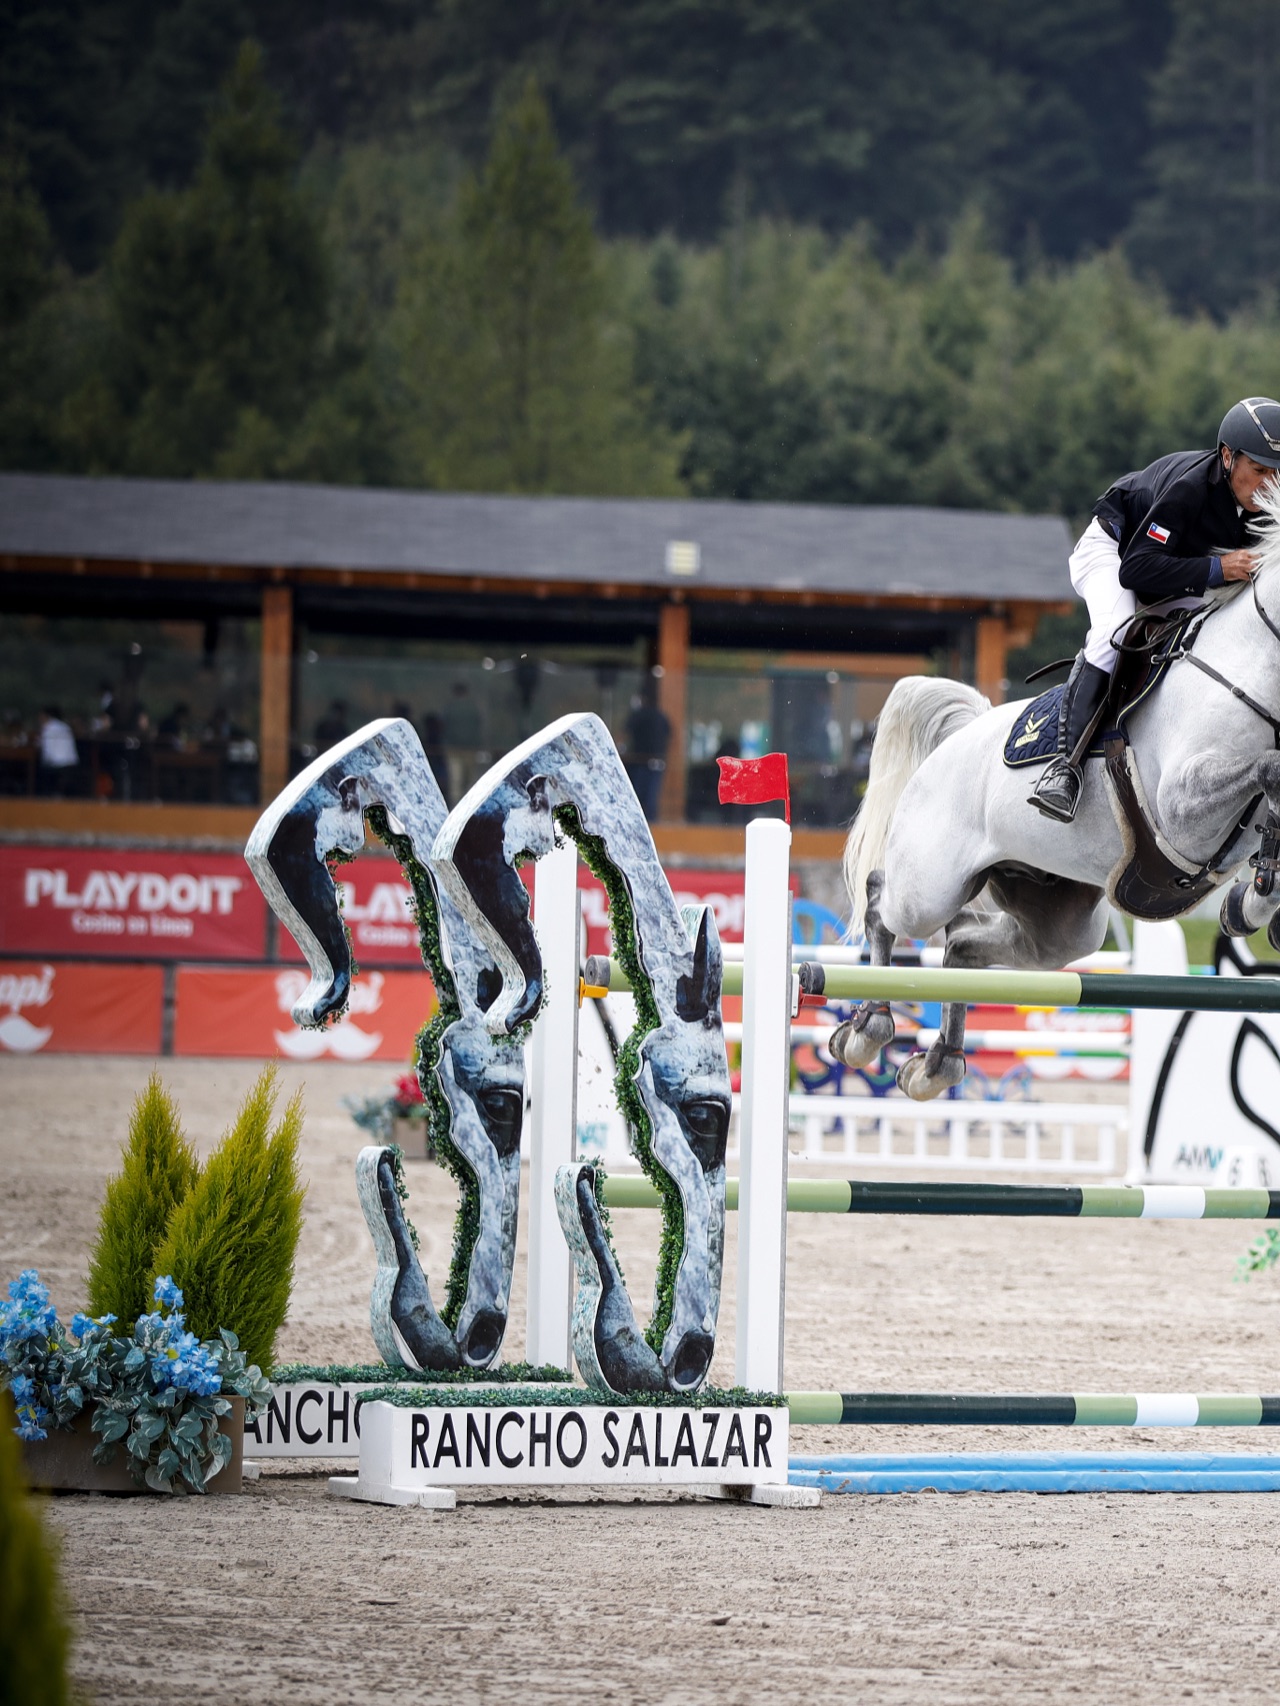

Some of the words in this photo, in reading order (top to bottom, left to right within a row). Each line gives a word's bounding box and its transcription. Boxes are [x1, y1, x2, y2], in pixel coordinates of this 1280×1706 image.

[25, 869, 241, 914] PLAYDOIT
[243, 1390, 361, 1445] NCH
[411, 1411, 588, 1469] RANCHO
[602, 1412, 772, 1469] SALAZAR
